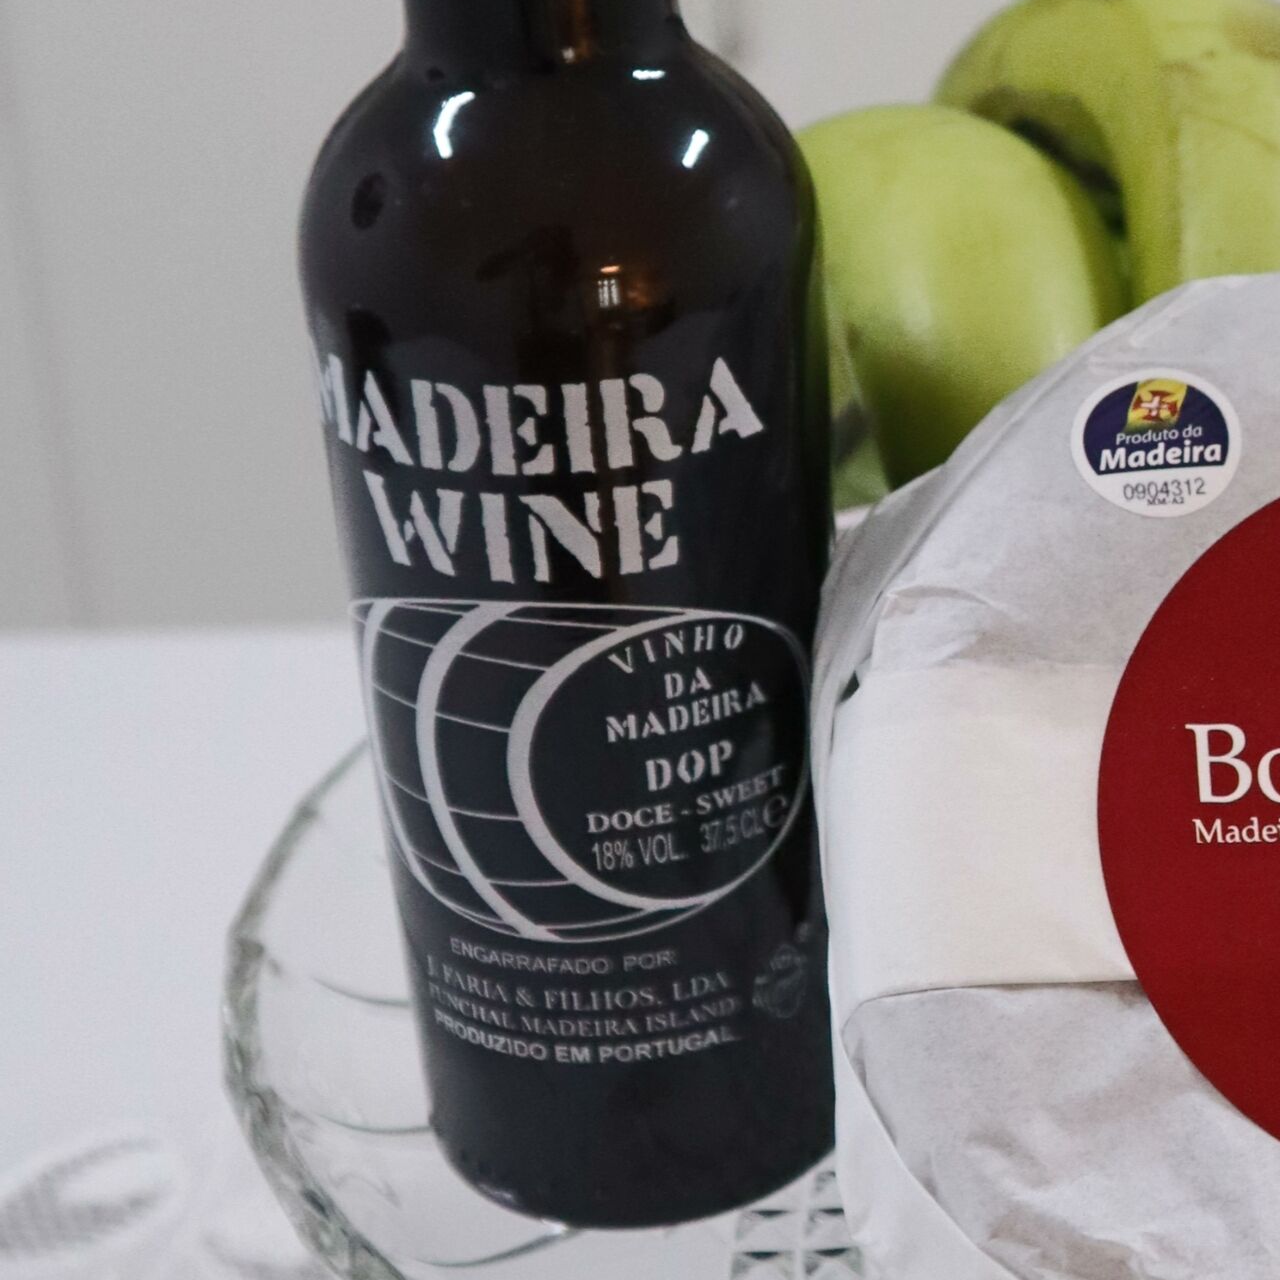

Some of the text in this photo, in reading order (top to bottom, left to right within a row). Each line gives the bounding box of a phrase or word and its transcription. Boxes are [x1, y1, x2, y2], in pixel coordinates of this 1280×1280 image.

[1099, 439, 1222, 472] Madeira
[1115, 424, 1203, 446] Produto da
[1123, 477, 1206, 501] 0904312
[362, 469, 680, 584] WINE
[607, 623, 745, 674] VINHO
[663, 666, 712, 699] DA
[605, 681, 767, 743] MADEIRA
[645, 739, 735, 793] DOP
[585, 803, 674, 834] DOCE
[696, 766, 786, 815] SWEET
[591, 839, 635, 872] 18%
[450, 936, 610, 976] ENGARRAFADO
[442, 962, 508, 1004] FARIA
[516, 987, 535, 1009] &
[434, 1007, 737, 1064] PRODUZIDO EM PORTUGAL
